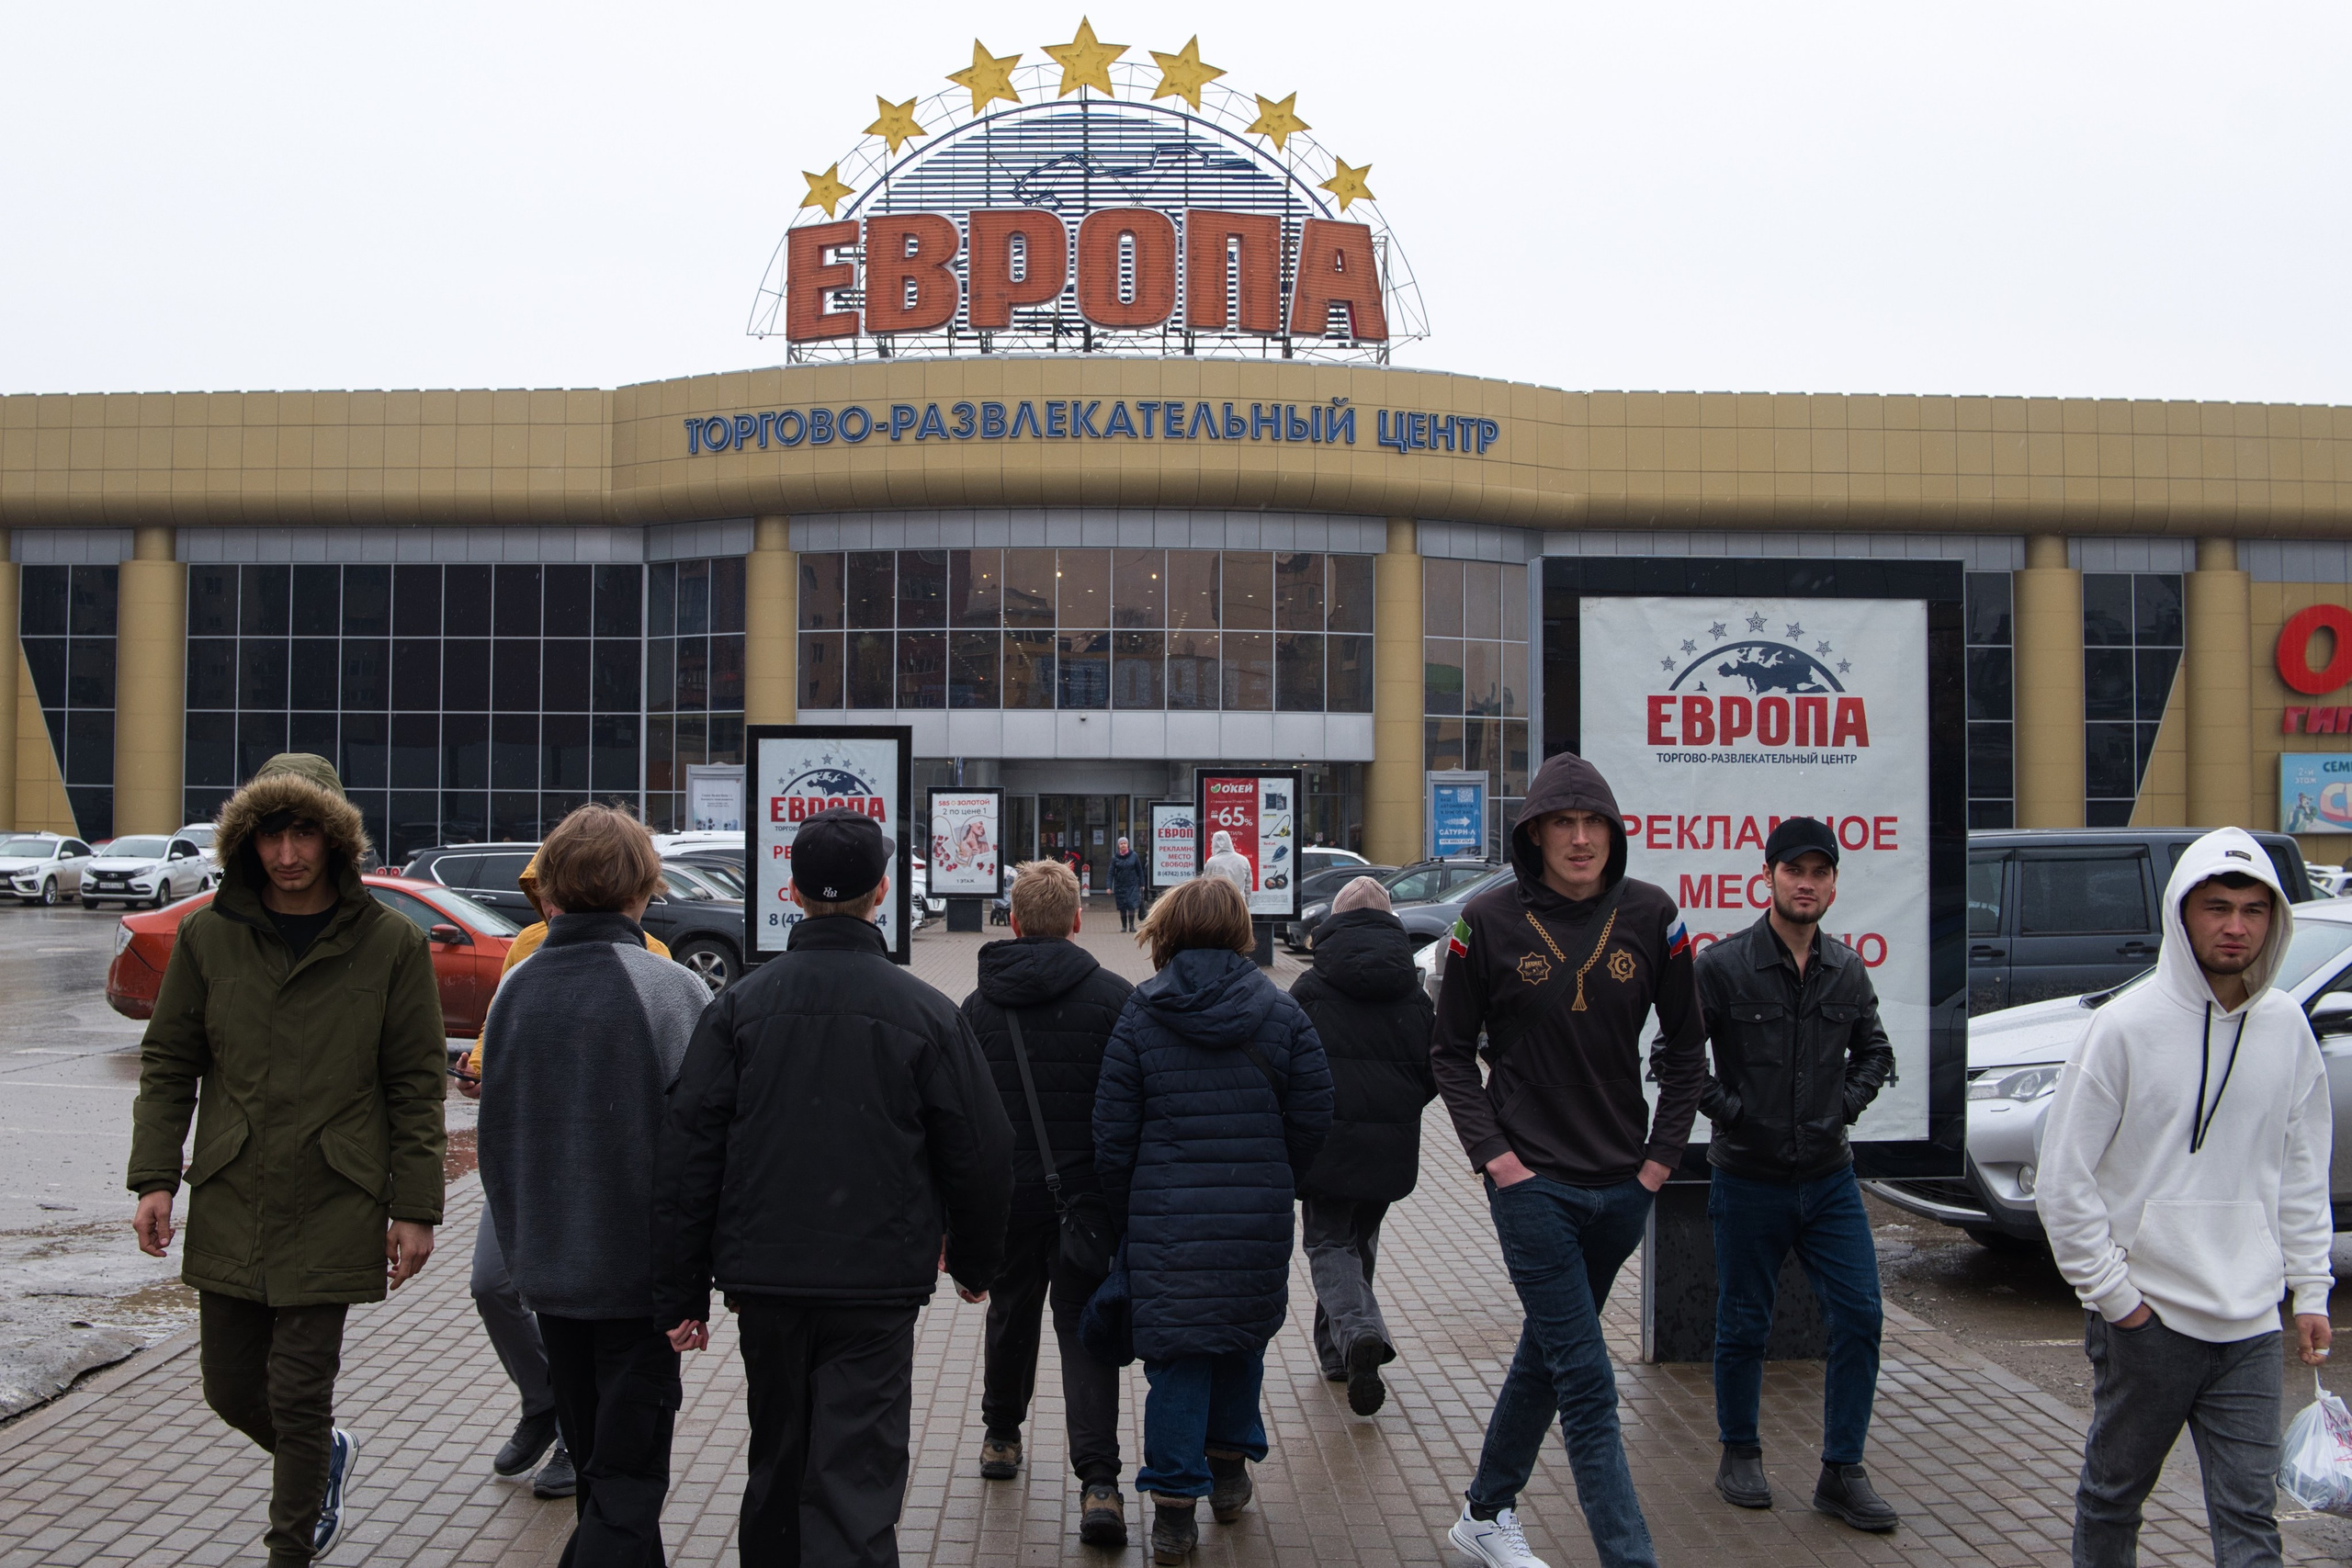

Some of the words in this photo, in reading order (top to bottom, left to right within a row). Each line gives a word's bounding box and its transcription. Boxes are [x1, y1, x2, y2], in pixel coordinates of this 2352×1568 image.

[786, 207, 1388, 343] ЕВРОПА
[684, 398, 1356, 455] ТОРГОВО-РАЗВЛЕКАТЕЛЬНЫЙ
[1378, 409, 1500, 455] ЦЕНТР
[1647, 694, 1870, 748] ЕВРОПА
[1657, 751, 1818, 764] ТОРГОВО-РАЗВЛЕКАТЕЛЬНЫЙ
[1821, 753, 1858, 765] ЦЕНТР
[2323, 761, 2352, 773] СЕМ
[1158, 828, 1194, 839] ЕВРОП
[1621, 814, 1898, 852] РЕКЛАОЕ
[769, 913, 778, 926] 8
